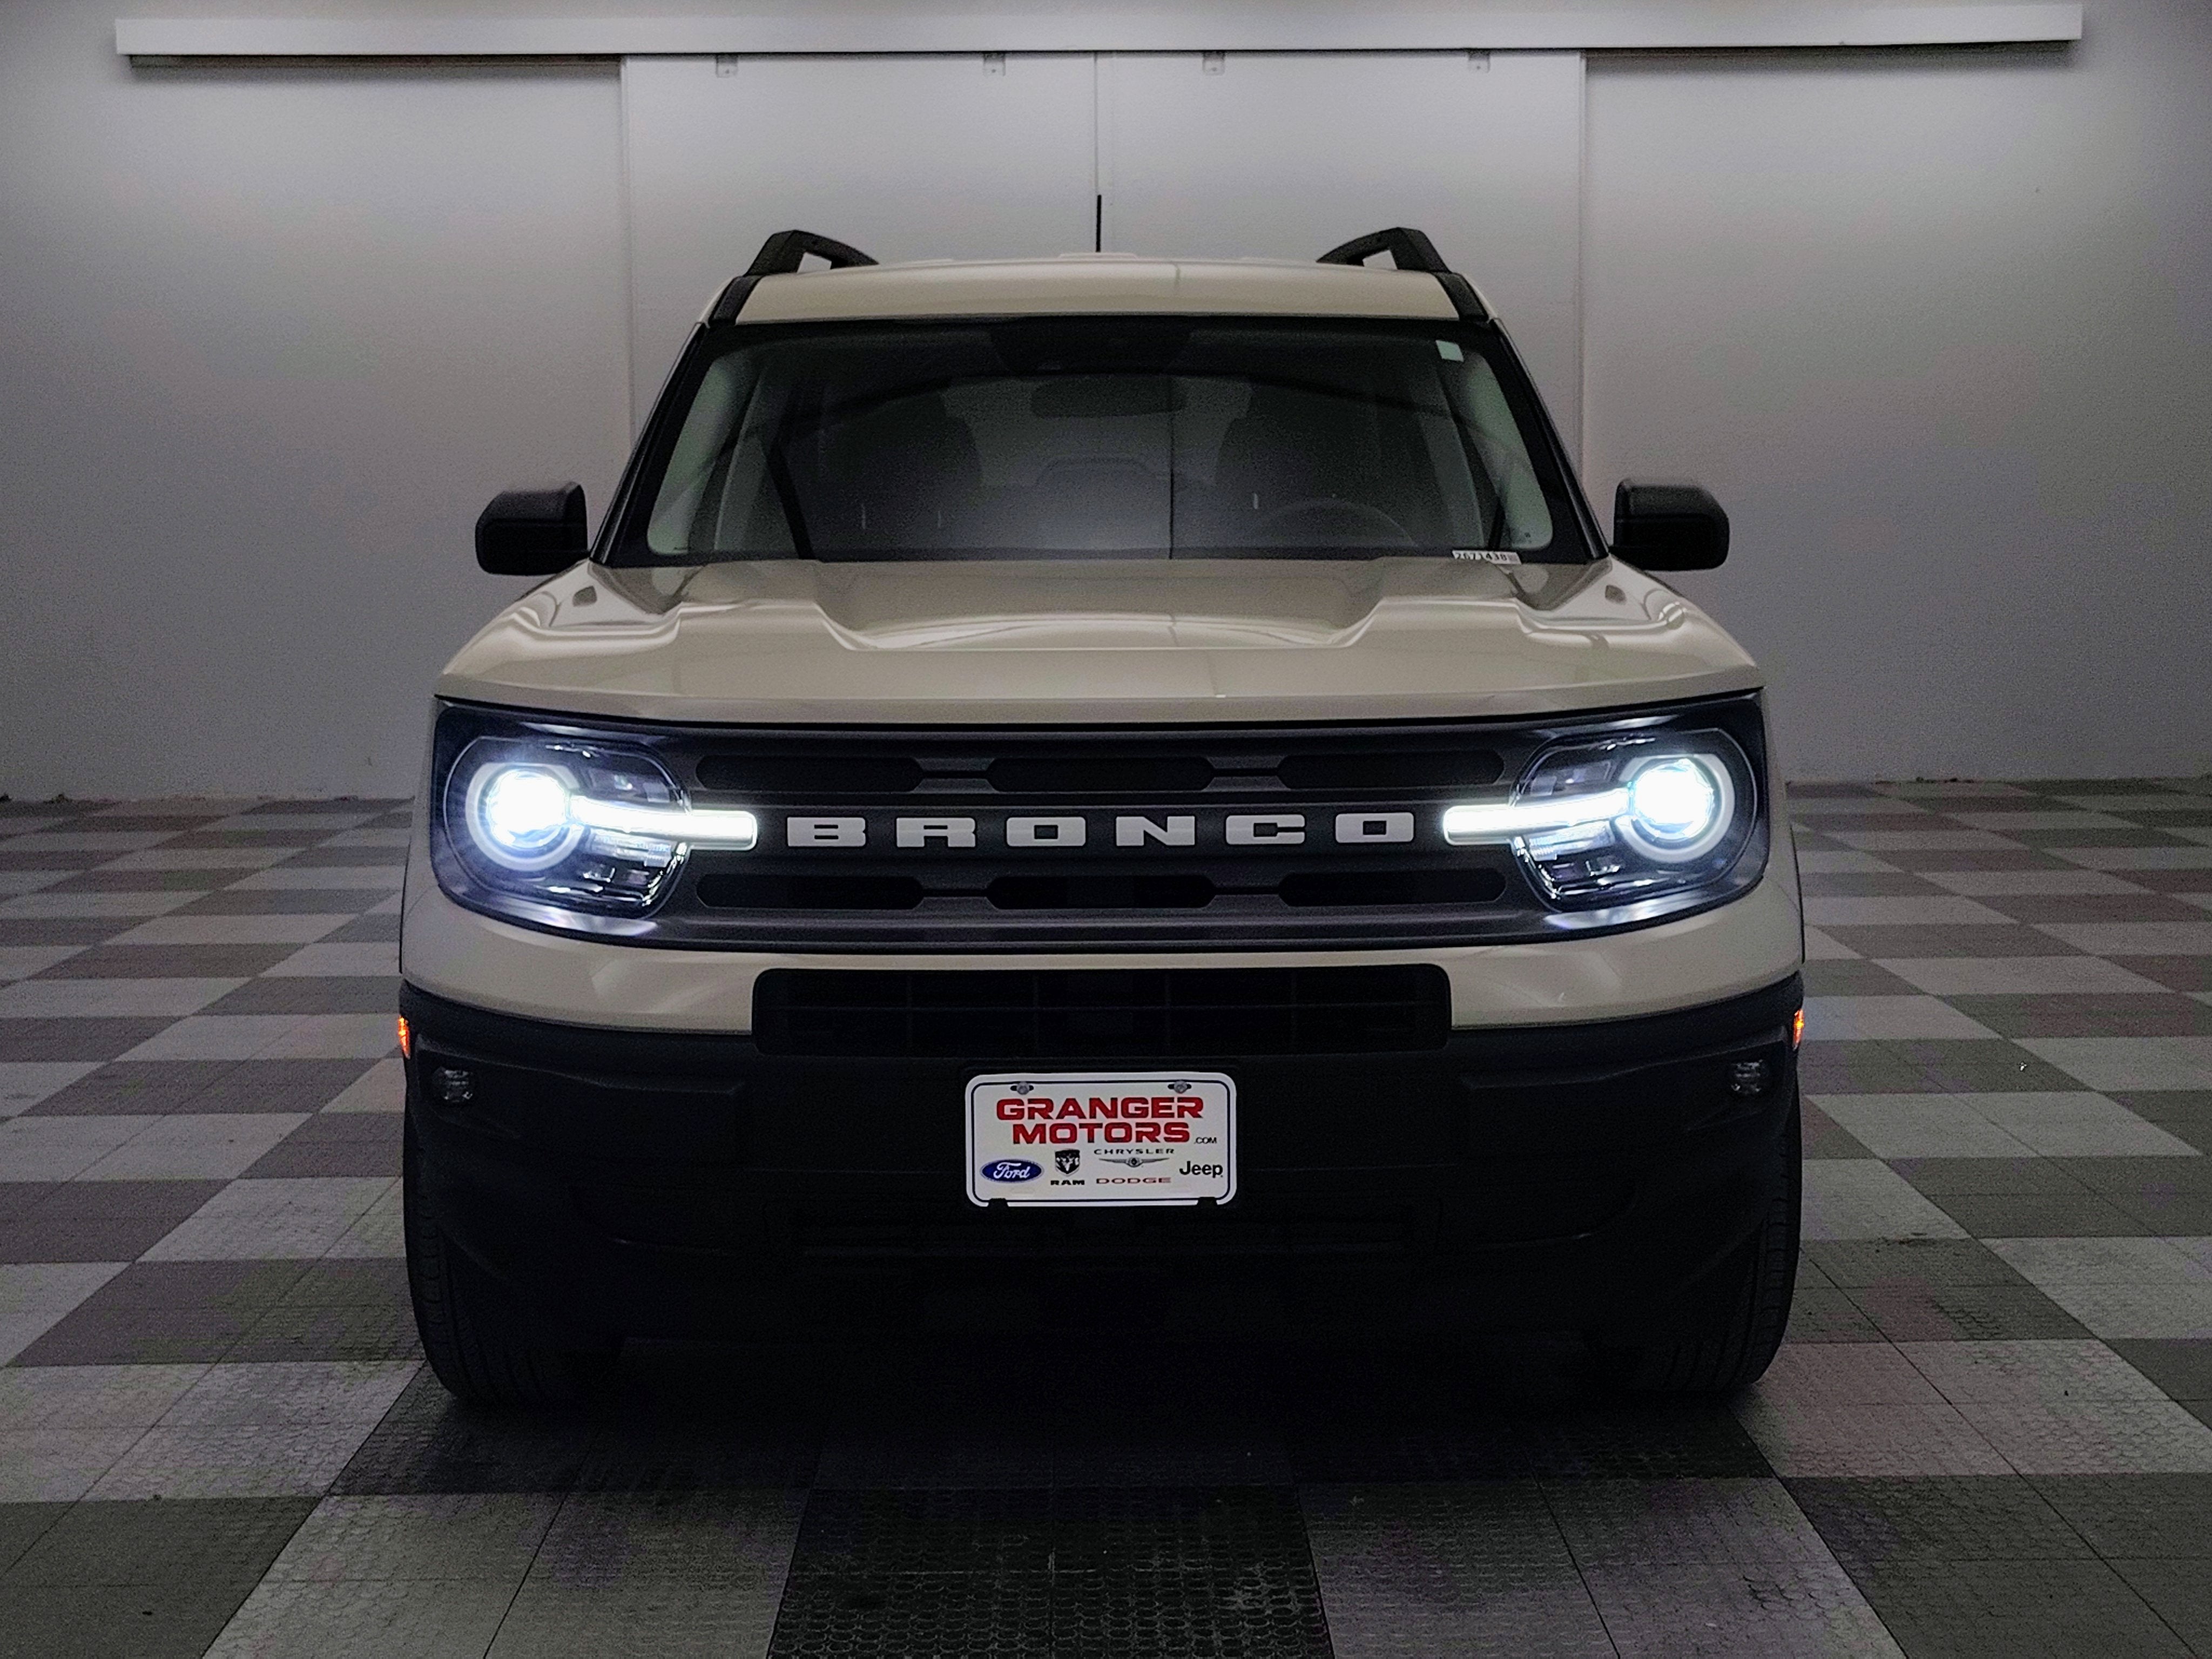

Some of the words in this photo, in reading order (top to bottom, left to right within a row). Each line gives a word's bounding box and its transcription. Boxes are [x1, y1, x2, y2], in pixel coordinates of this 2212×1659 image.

[787, 812, 1414, 847] BRONCO
[996, 1097, 1204, 1121] GRANGER
[1013, 1122, 1190, 1144] MOTORS
[993, 1162, 1030, 1179] Ford
[1179, 1161, 1223, 1178] Jeep
